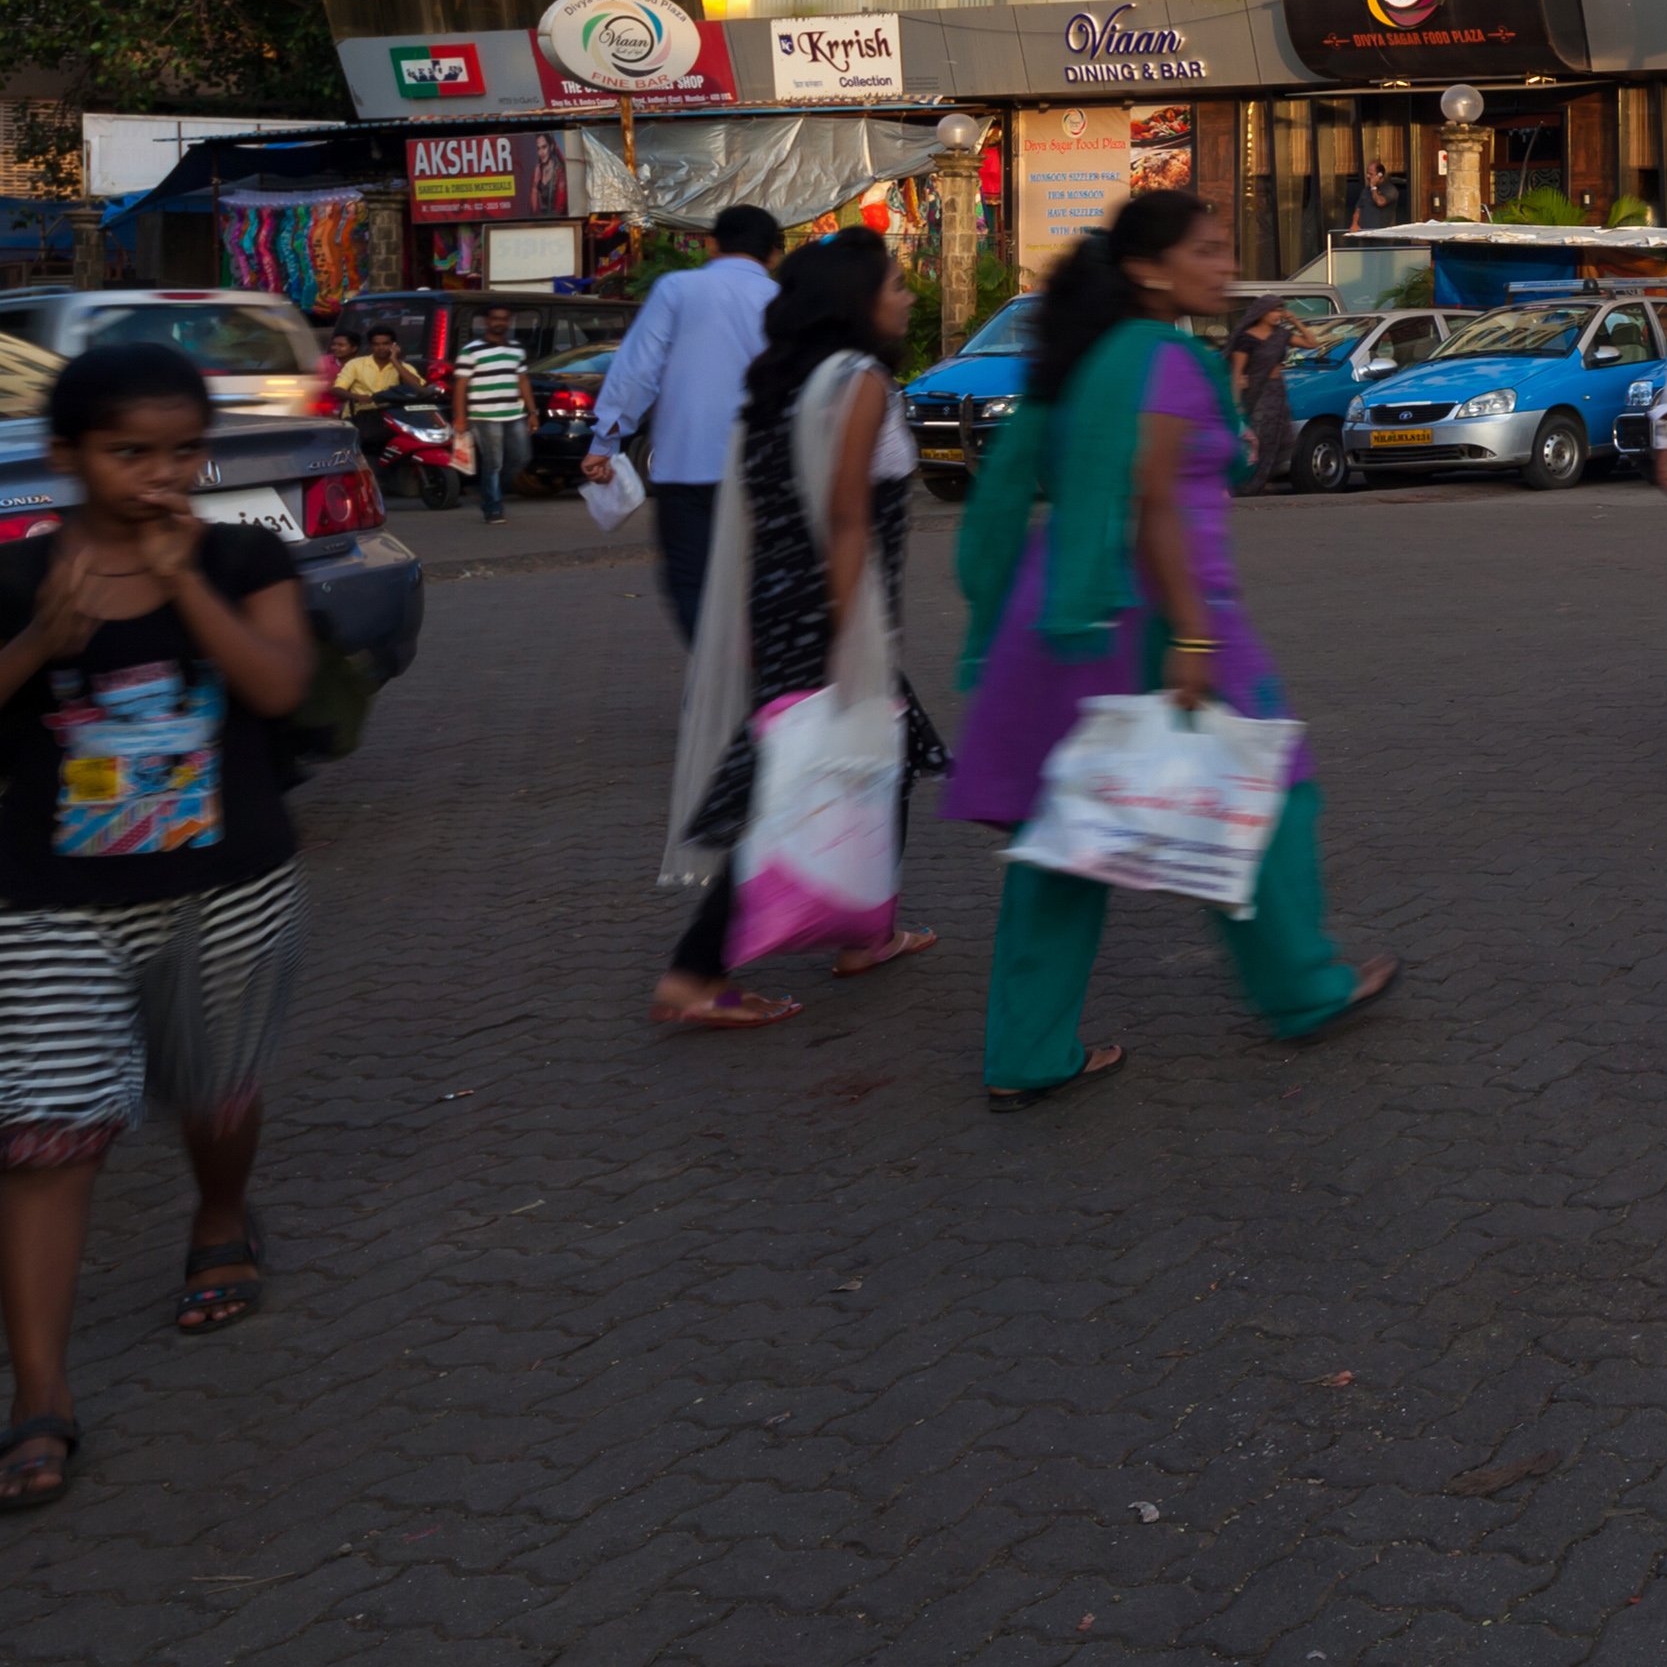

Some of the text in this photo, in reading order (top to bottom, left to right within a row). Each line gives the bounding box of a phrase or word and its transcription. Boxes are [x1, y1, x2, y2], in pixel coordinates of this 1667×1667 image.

[661, 0, 687, 23] Plaza
[1065, 3, 1184, 60] Viaan
[1353, 29, 1486, 48] DIVYA SAGAR FOOD PLAZA
[797, 28, 892, 72] Krrish
[591, 72, 670, 89] FINE BAR
[839, 76, 892, 88] Collection
[1065, 60, 1206, 83] DINING & BAR
[561, 75, 704, 94] THE SHOP
[414, 138, 513, 176] AKSHAR
[0, 494, 53, 508] ONDA
